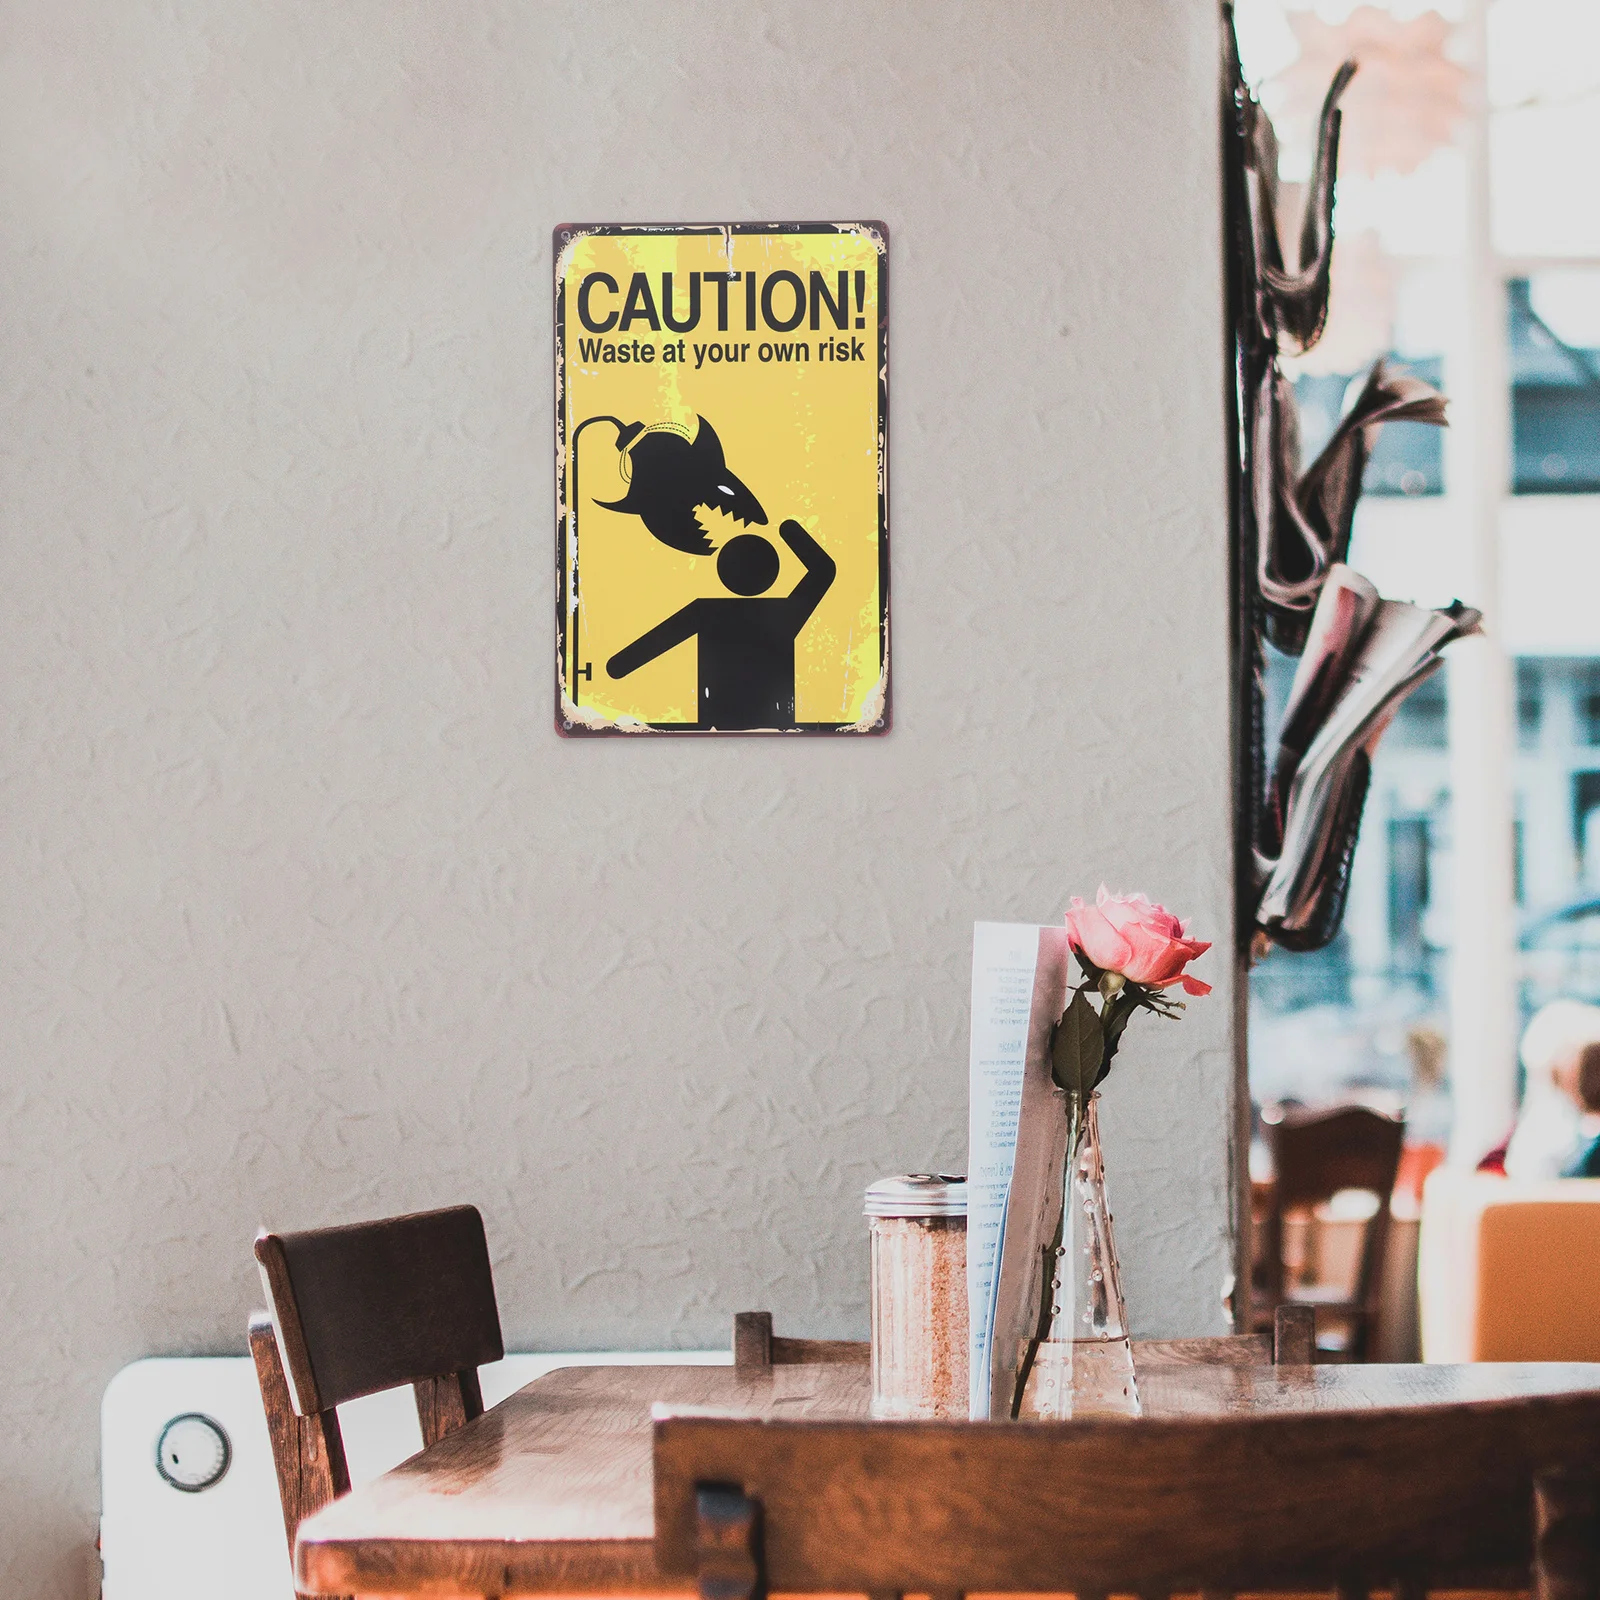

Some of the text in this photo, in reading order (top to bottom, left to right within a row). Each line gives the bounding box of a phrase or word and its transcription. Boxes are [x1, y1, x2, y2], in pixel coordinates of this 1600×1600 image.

[577, 270, 866, 333] CAUTION!
[578, 336, 866, 370] Waste at your own risk
